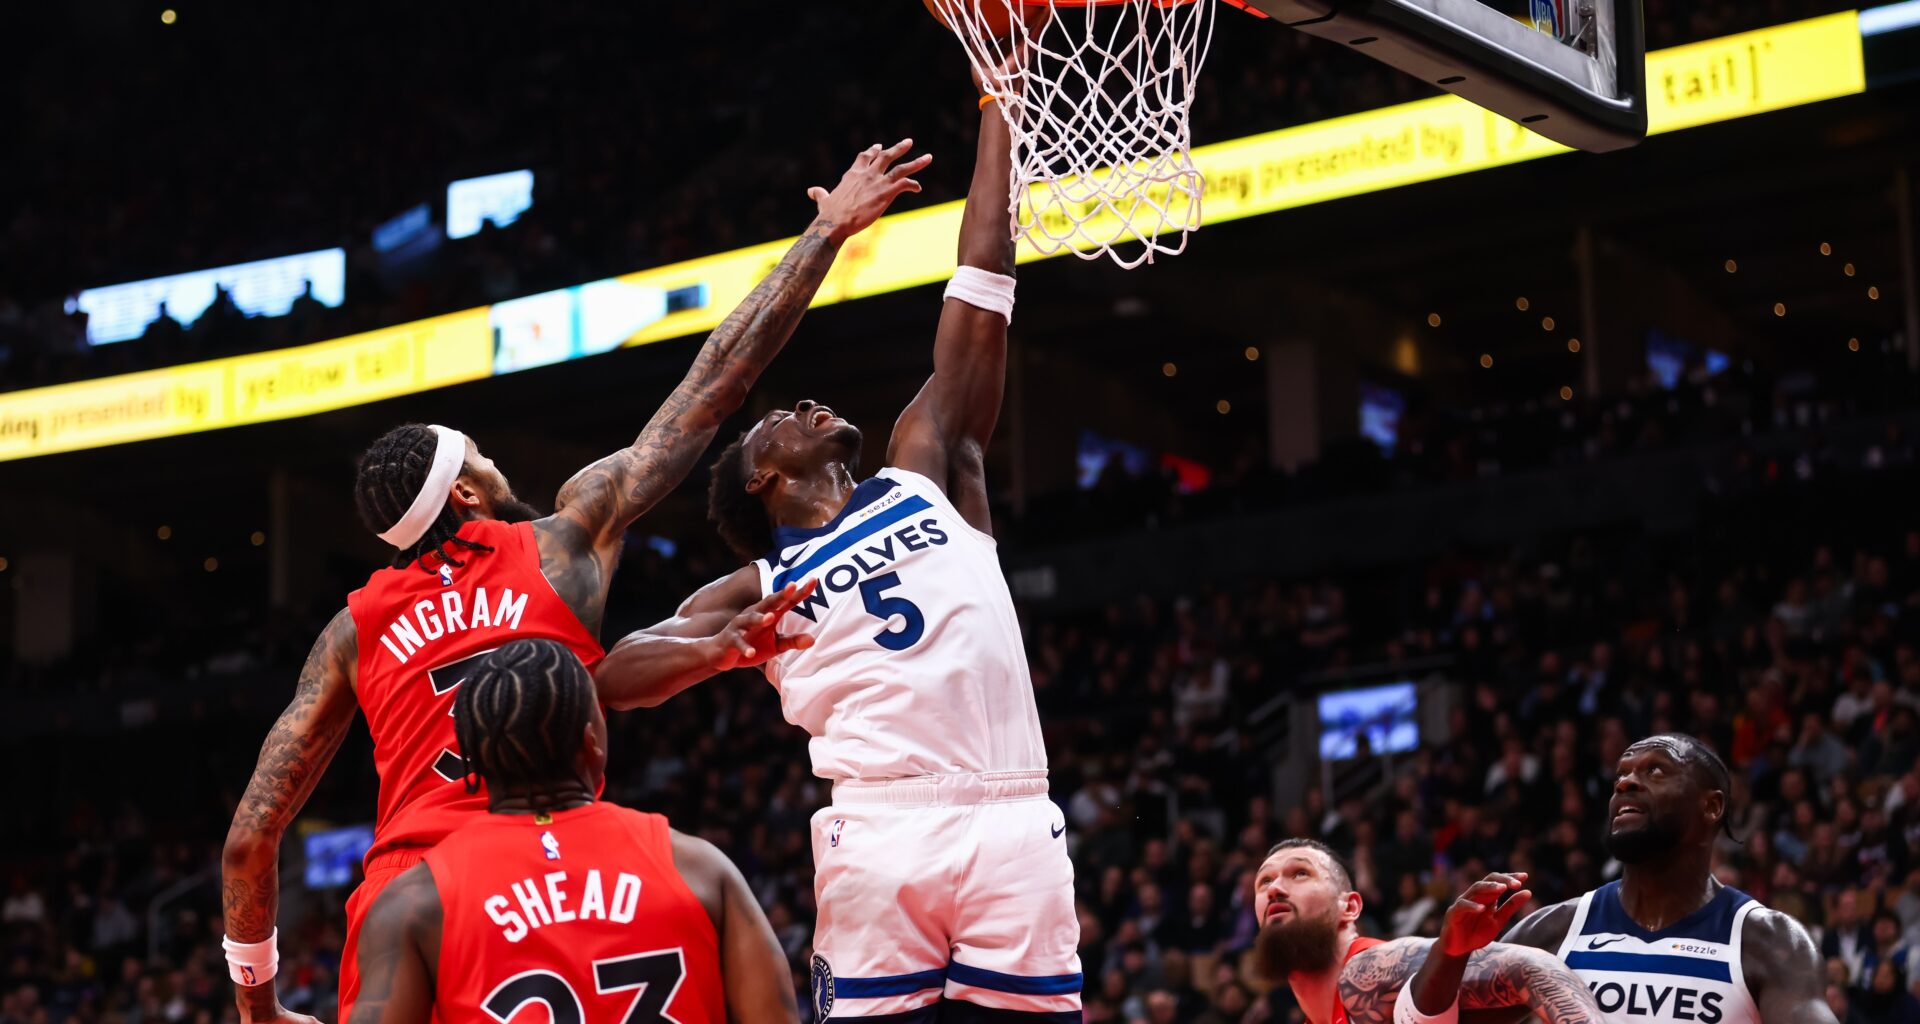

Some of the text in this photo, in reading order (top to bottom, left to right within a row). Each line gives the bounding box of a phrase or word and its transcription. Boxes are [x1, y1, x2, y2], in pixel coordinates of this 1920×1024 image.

[867, 490, 902, 513] sezzle
[791, 518, 949, 624] WOLVES
[380, 587, 529, 664] INGRAM
[858, 570, 925, 652] 5
[484, 869, 642, 943] SHEAD
[1679, 944, 1718, 956] sezzle
[1588, 980, 1724, 1024] OLVES
